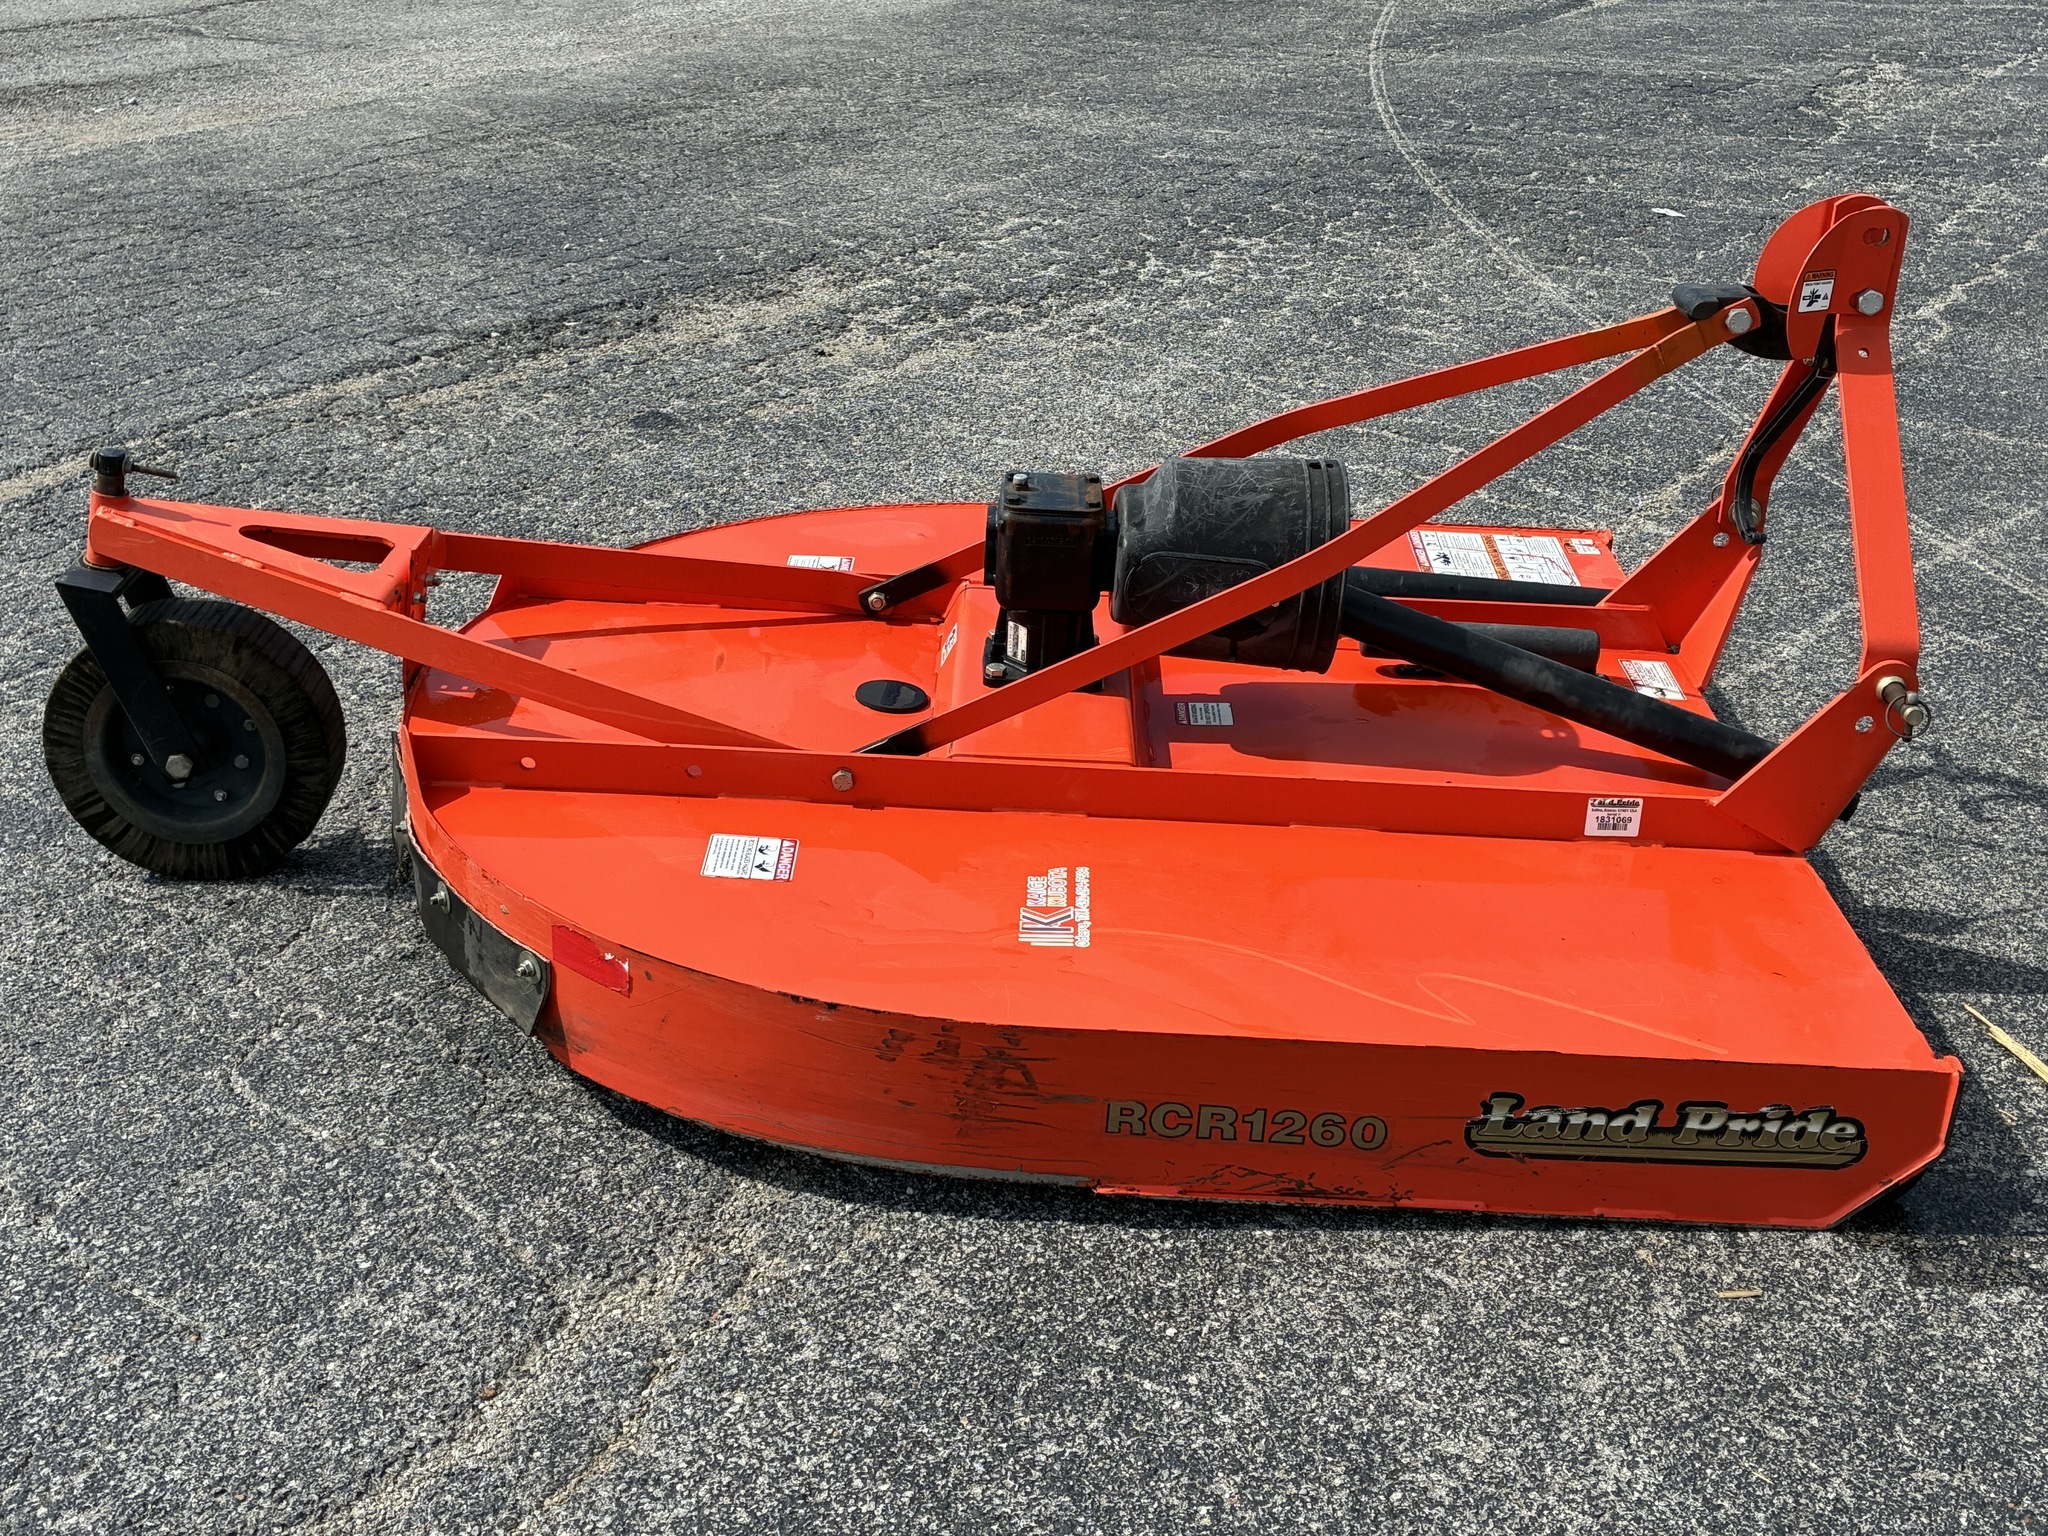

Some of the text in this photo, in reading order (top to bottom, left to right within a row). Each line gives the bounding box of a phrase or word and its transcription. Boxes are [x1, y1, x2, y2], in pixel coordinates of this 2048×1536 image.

[1811, 271, 1834, 279] WARNING
[1177, 702, 1186, 721] DANGER
[1595, 815, 1633, 824] 1831069
[775, 847, 796, 880] DANGER
[1026, 875, 1047, 907] KAIGE
[1047, 866, 1068, 907] KUBOTA
[1105, 1100, 1389, 1151] RCR1260
[1477, 1096, 1861, 1151] Land Pride
